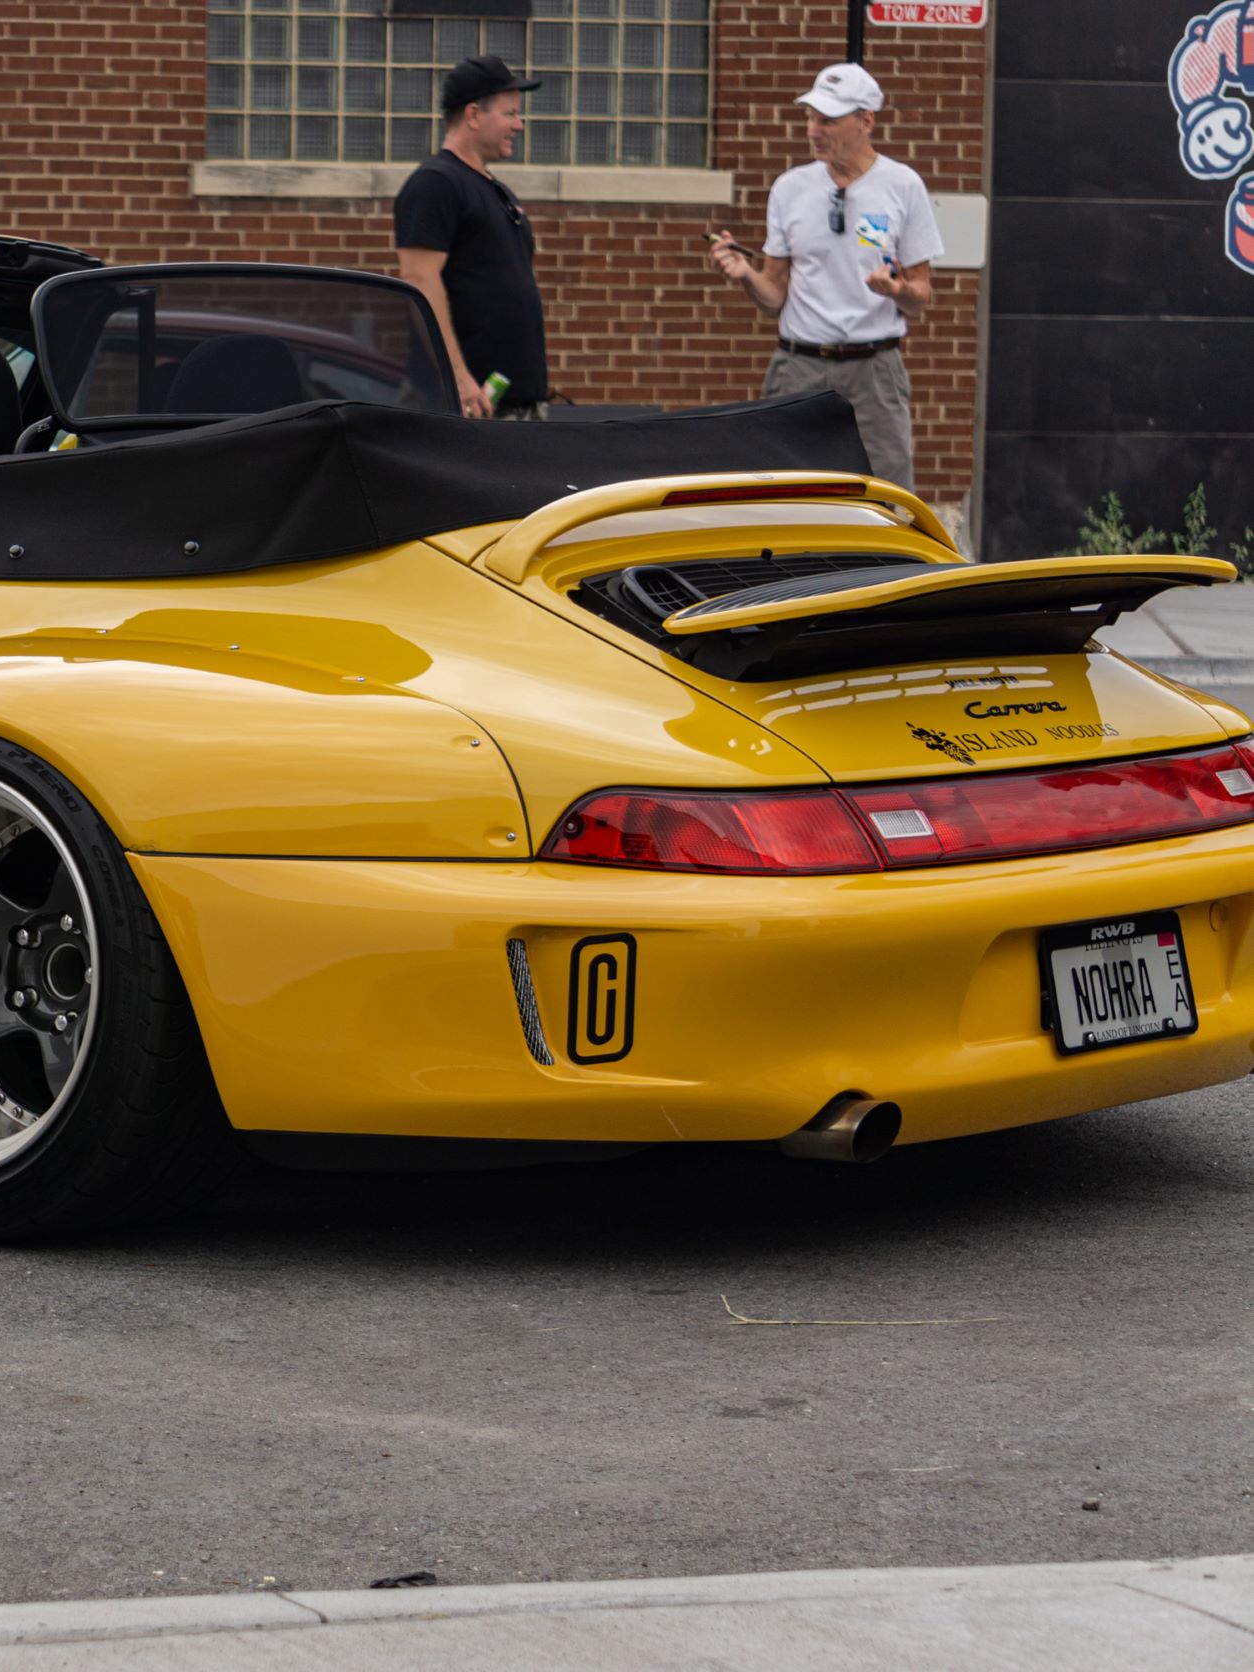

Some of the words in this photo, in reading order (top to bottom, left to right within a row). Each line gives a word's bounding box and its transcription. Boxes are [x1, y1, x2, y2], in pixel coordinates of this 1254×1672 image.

[882, 5, 920, 22] TOW
[924, 6, 973, 23] ZONE
[963, 700, 1067, 719] Carrera
[954, 728, 1038, 752] ISLAND
[1045, 723, 1120, 740] NOODLES
[1091, 922, 1136, 940] RWB
[1072, 958, 1157, 1026] NOHRA
[1096, 1028, 1117, 1041] LAND
[1128, 1021, 1160, 1036] LINCOLN
